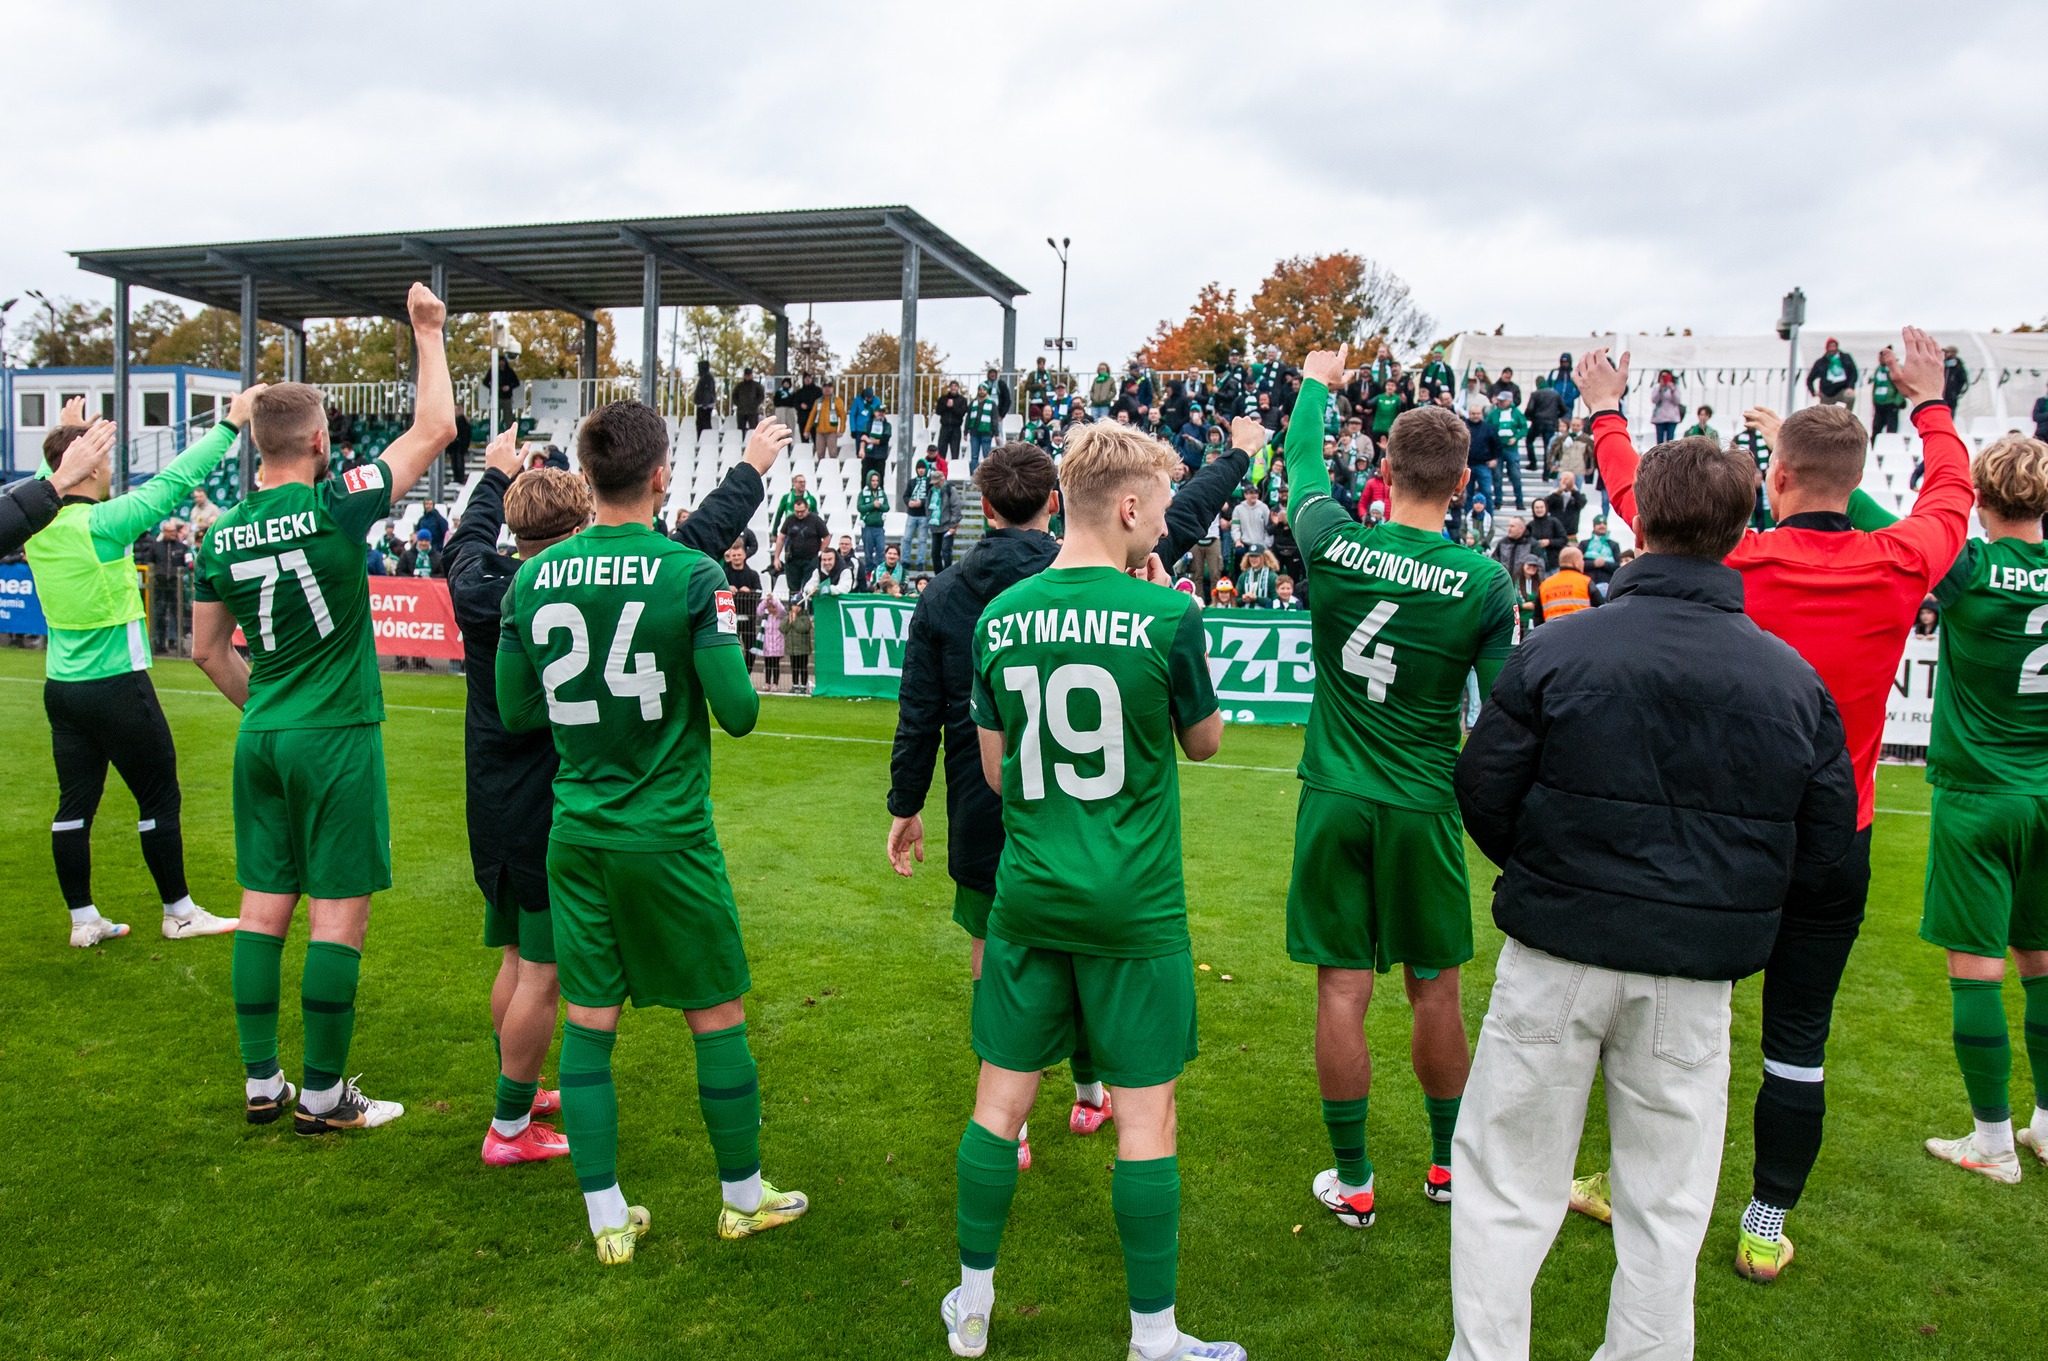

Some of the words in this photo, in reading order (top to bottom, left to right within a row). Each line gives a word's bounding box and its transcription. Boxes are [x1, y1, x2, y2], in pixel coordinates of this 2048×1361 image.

[214, 511, 317, 554] STEBLECKI
[533, 556, 662, 590] AVDIEIEV
[1324, 535, 1468, 598] WOJCINOWICZ
[230, 549, 335, 651] 71
[987, 608, 1155, 652] SZYMANEK
[531, 602, 667, 725] 24
[1342, 600, 1399, 703] 4
[2017, 603, 2048, 694] 2
[1003, 663, 1126, 801] 19
